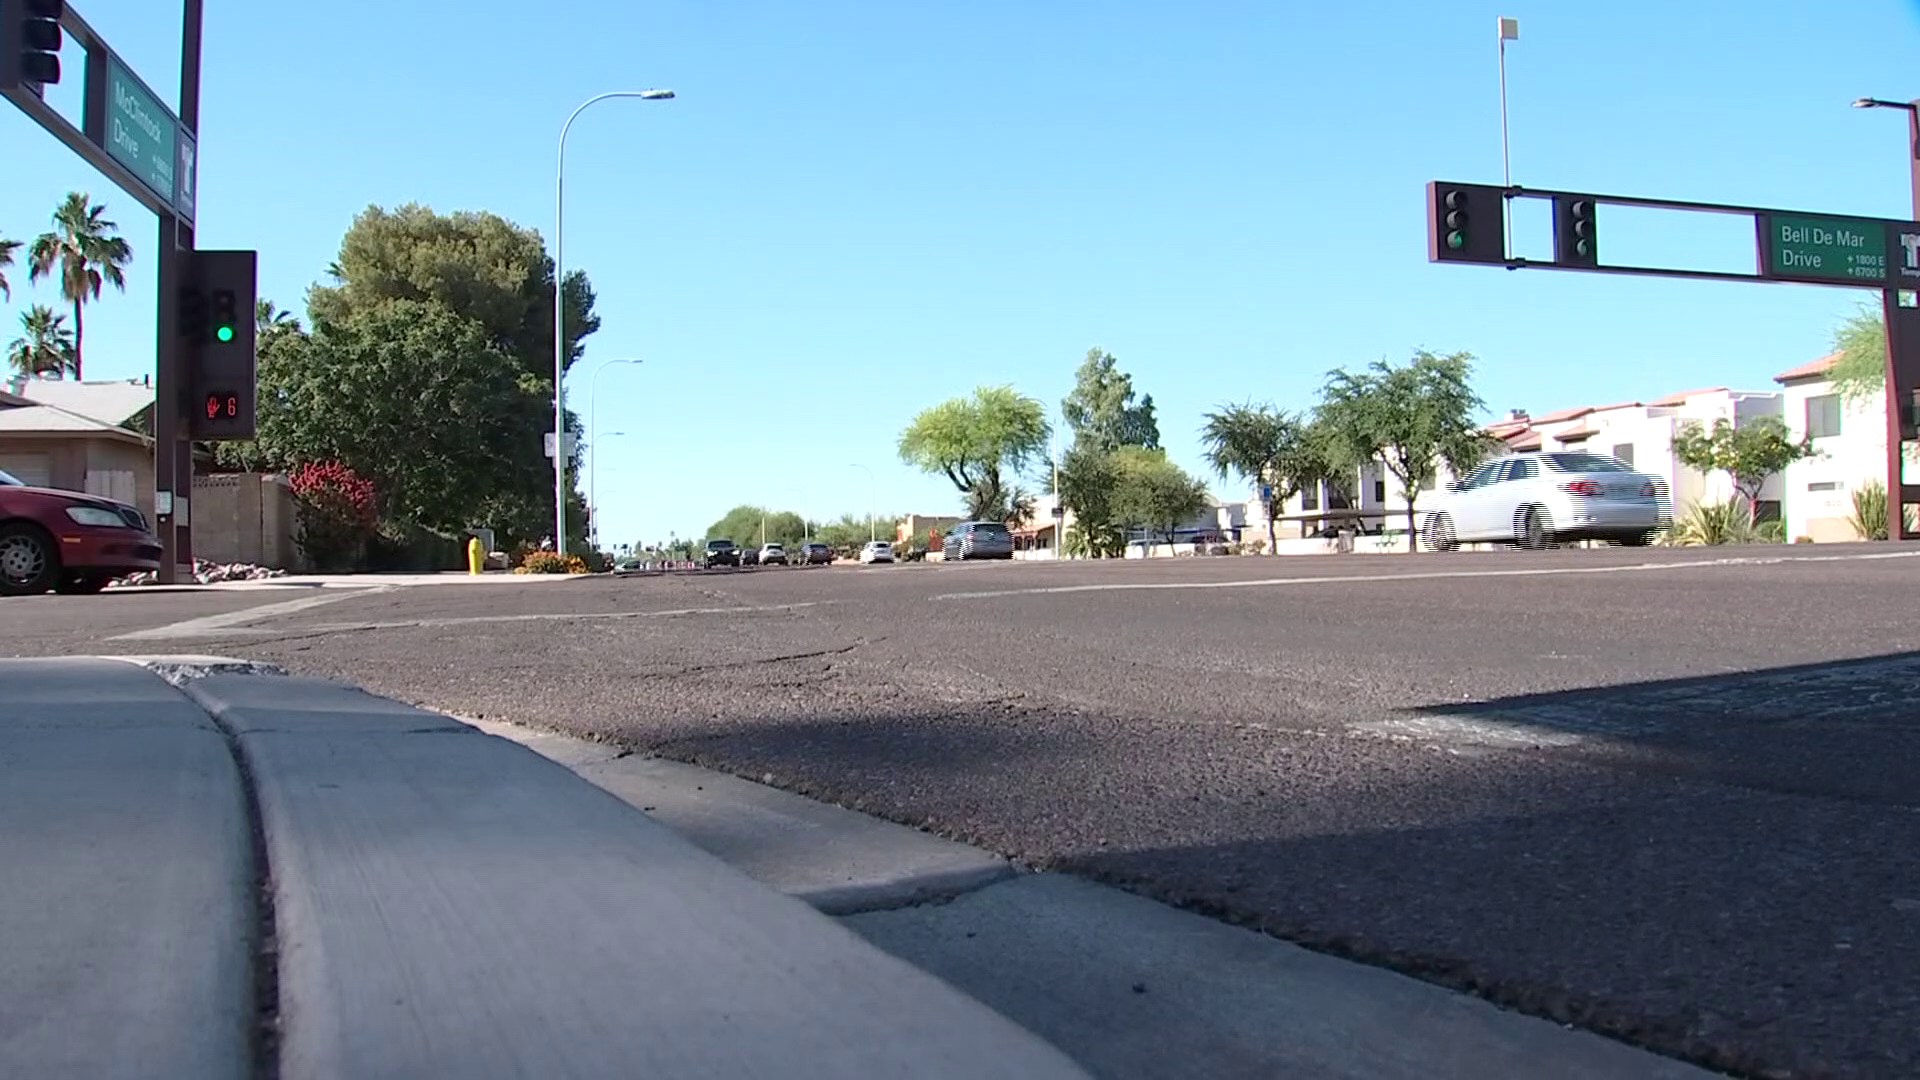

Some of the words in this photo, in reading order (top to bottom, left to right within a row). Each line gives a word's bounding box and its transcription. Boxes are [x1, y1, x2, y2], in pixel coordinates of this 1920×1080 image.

[114, 117, 139, 159] Drive
[1781, 225, 1809, 243] Bell
[1813, 228, 1833, 245] De
[1836, 230, 1864, 248] Mar
[1783, 250, 1822, 268] Drive
[1855, 254, 1877, 265] 1800
[1878, 256, 1886, 266] E
[227, 397, 236, 416] 6
